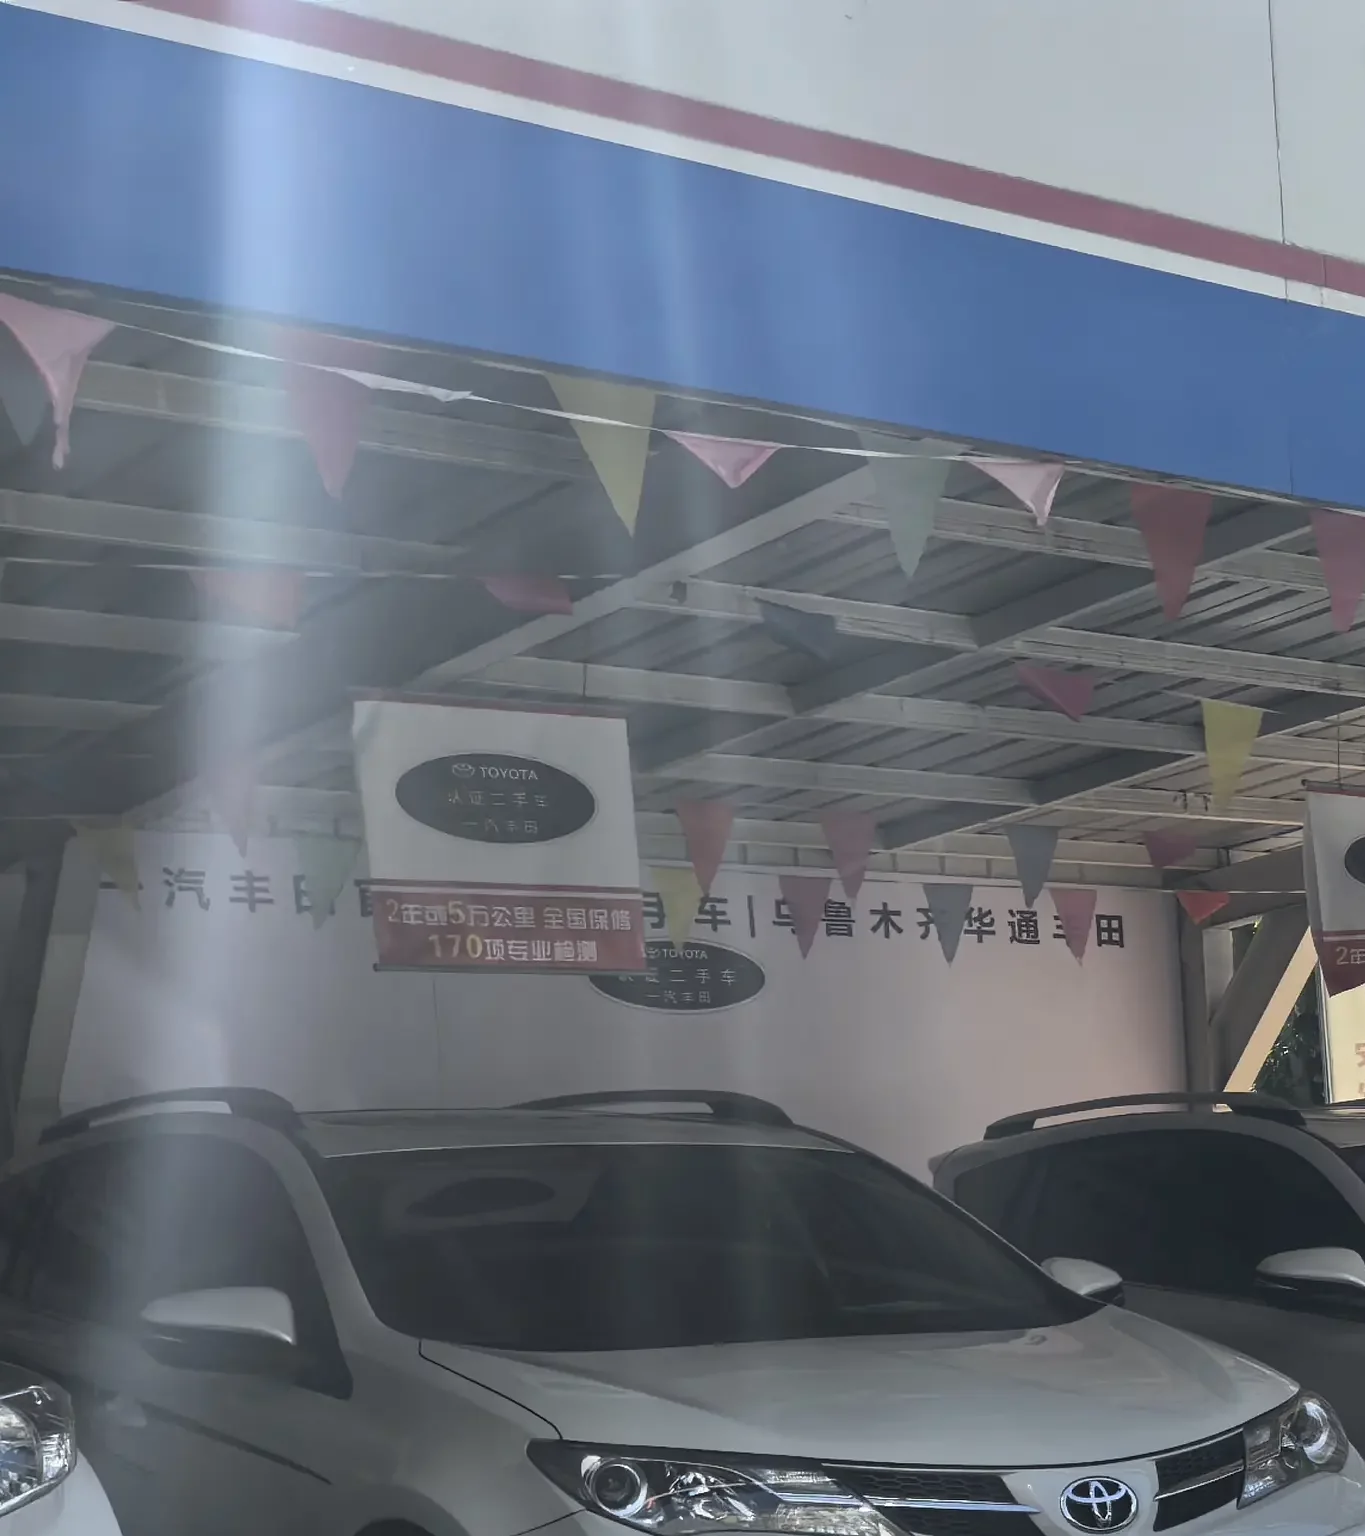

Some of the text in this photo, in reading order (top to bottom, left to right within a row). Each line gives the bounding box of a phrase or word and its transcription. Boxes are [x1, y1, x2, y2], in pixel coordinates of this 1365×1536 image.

[480, 766, 538, 781] TOYOTA
[386, 899, 631, 931] 2年或5万公里 全国保修
[429, 934, 598, 963] 170项专业检测
[662, 948, 708, 960] TOYOTA
